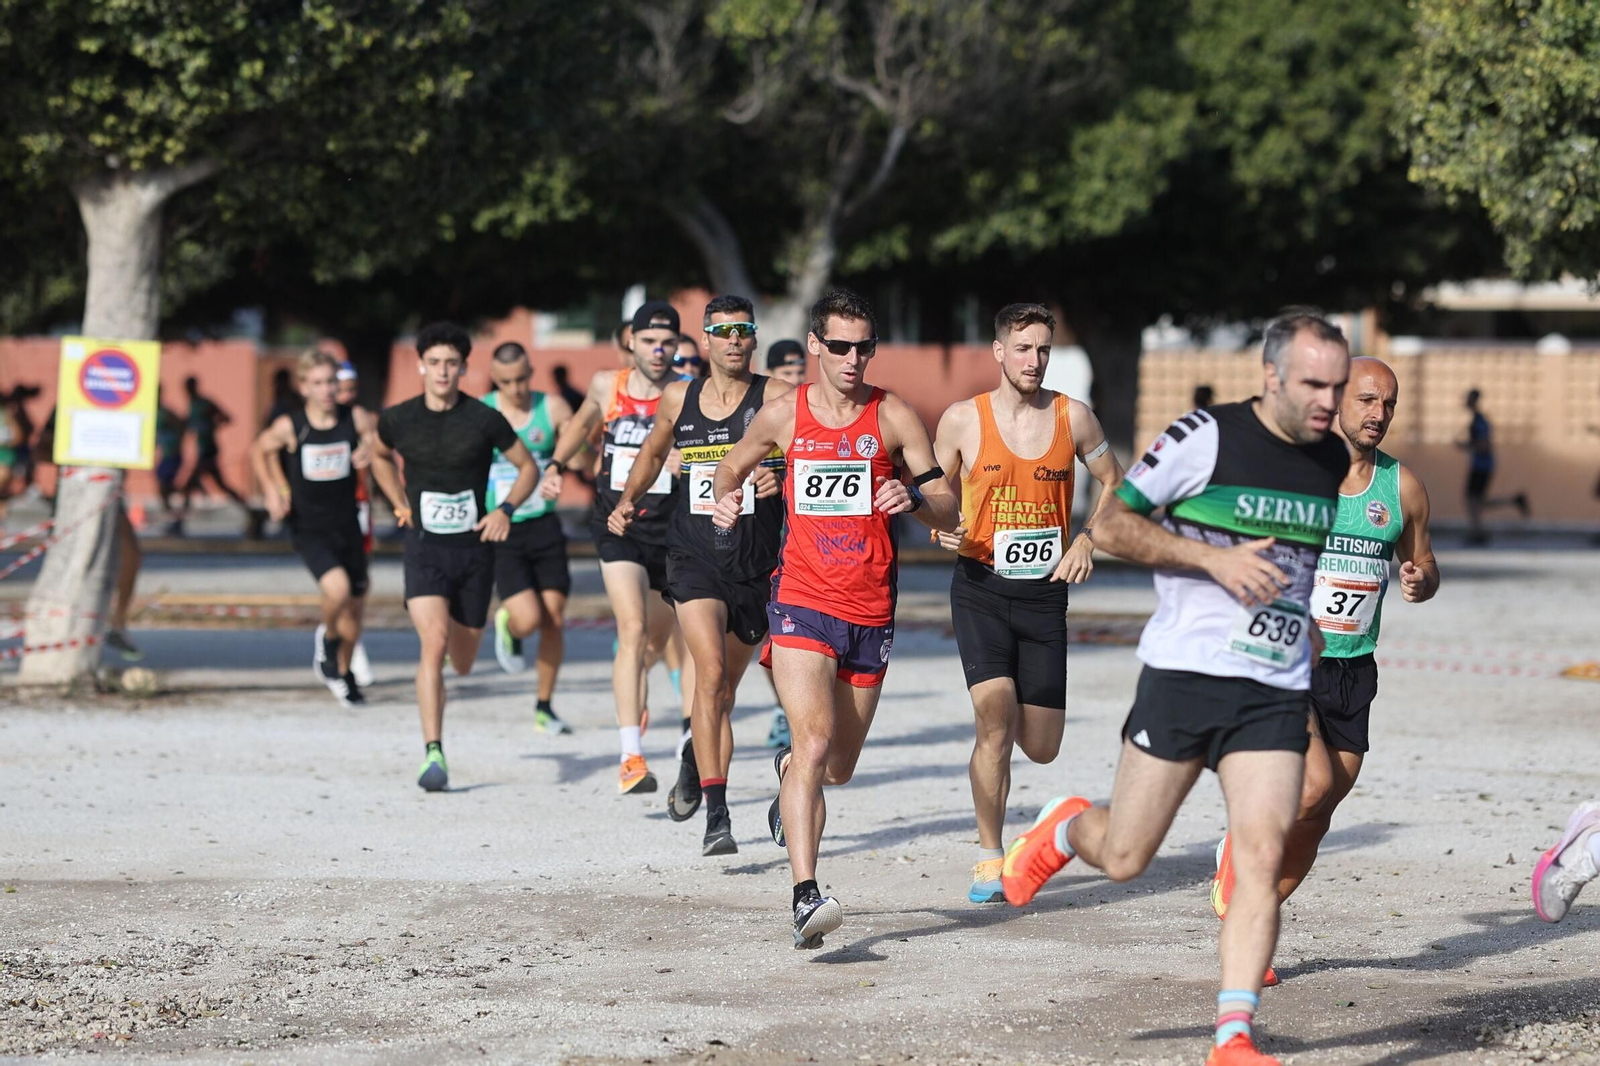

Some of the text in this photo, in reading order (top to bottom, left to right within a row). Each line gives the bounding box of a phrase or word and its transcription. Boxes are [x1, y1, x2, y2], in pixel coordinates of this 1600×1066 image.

[680, 424, 694, 432] vive
[708, 433, 729, 444] gross
[983, 464, 1001, 472] vive
[698, 480, 713, 499] 2
[805, 474, 861, 498] 876
[991, 486, 1017, 501] XII
[432, 504, 468, 521] 735
[990, 499, 1058, 514] TRIATLÓN
[997, 513, 1046, 524] BENAL
[1005, 540, 1054, 564] 696
[1326, 535, 1383, 556] LETISMO
[821, 557, 862, 567] DENTAL
[1319, 556, 1385, 576] REMOLINOS
[1326, 591, 1367, 617] 37
[1248, 611, 1302, 646] 639
